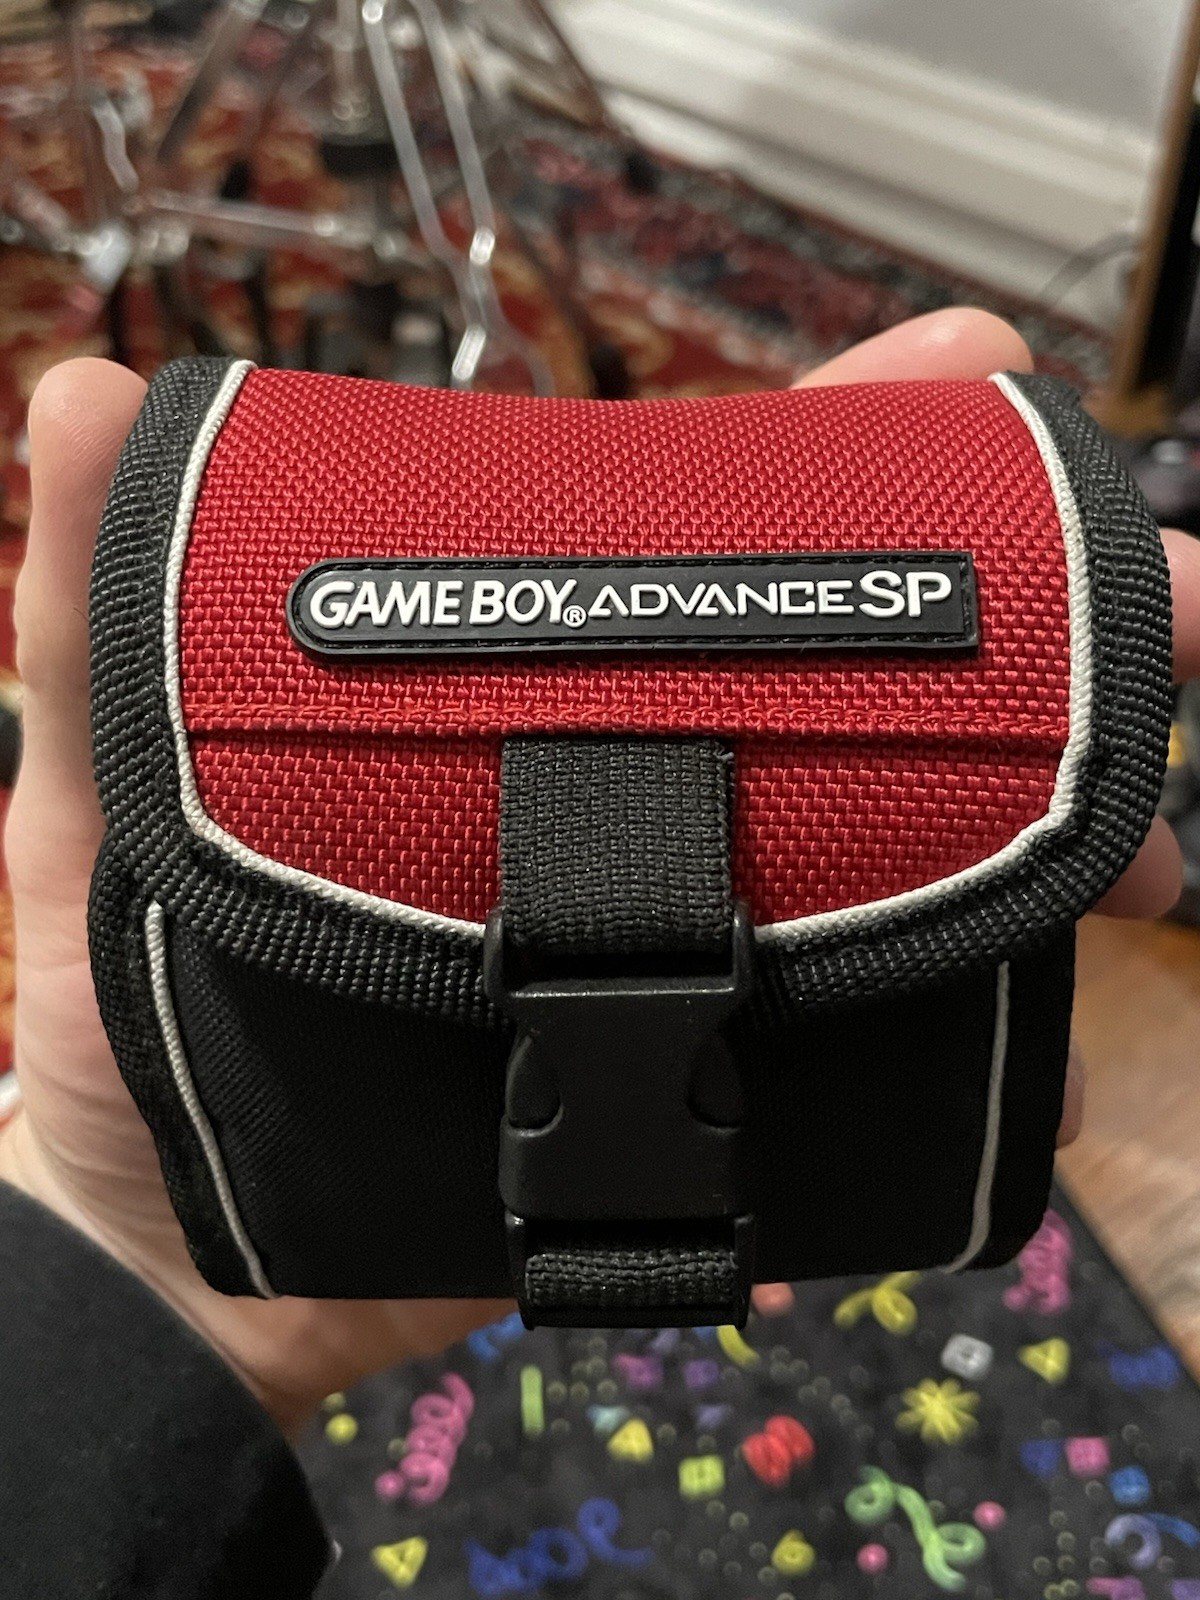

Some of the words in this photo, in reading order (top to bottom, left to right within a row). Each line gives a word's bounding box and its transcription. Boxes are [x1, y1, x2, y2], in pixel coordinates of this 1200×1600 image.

[309, 579, 463, 629] GAME
[587, 579, 855, 618] ADVANCE
[858, 570, 953, 618] SP
